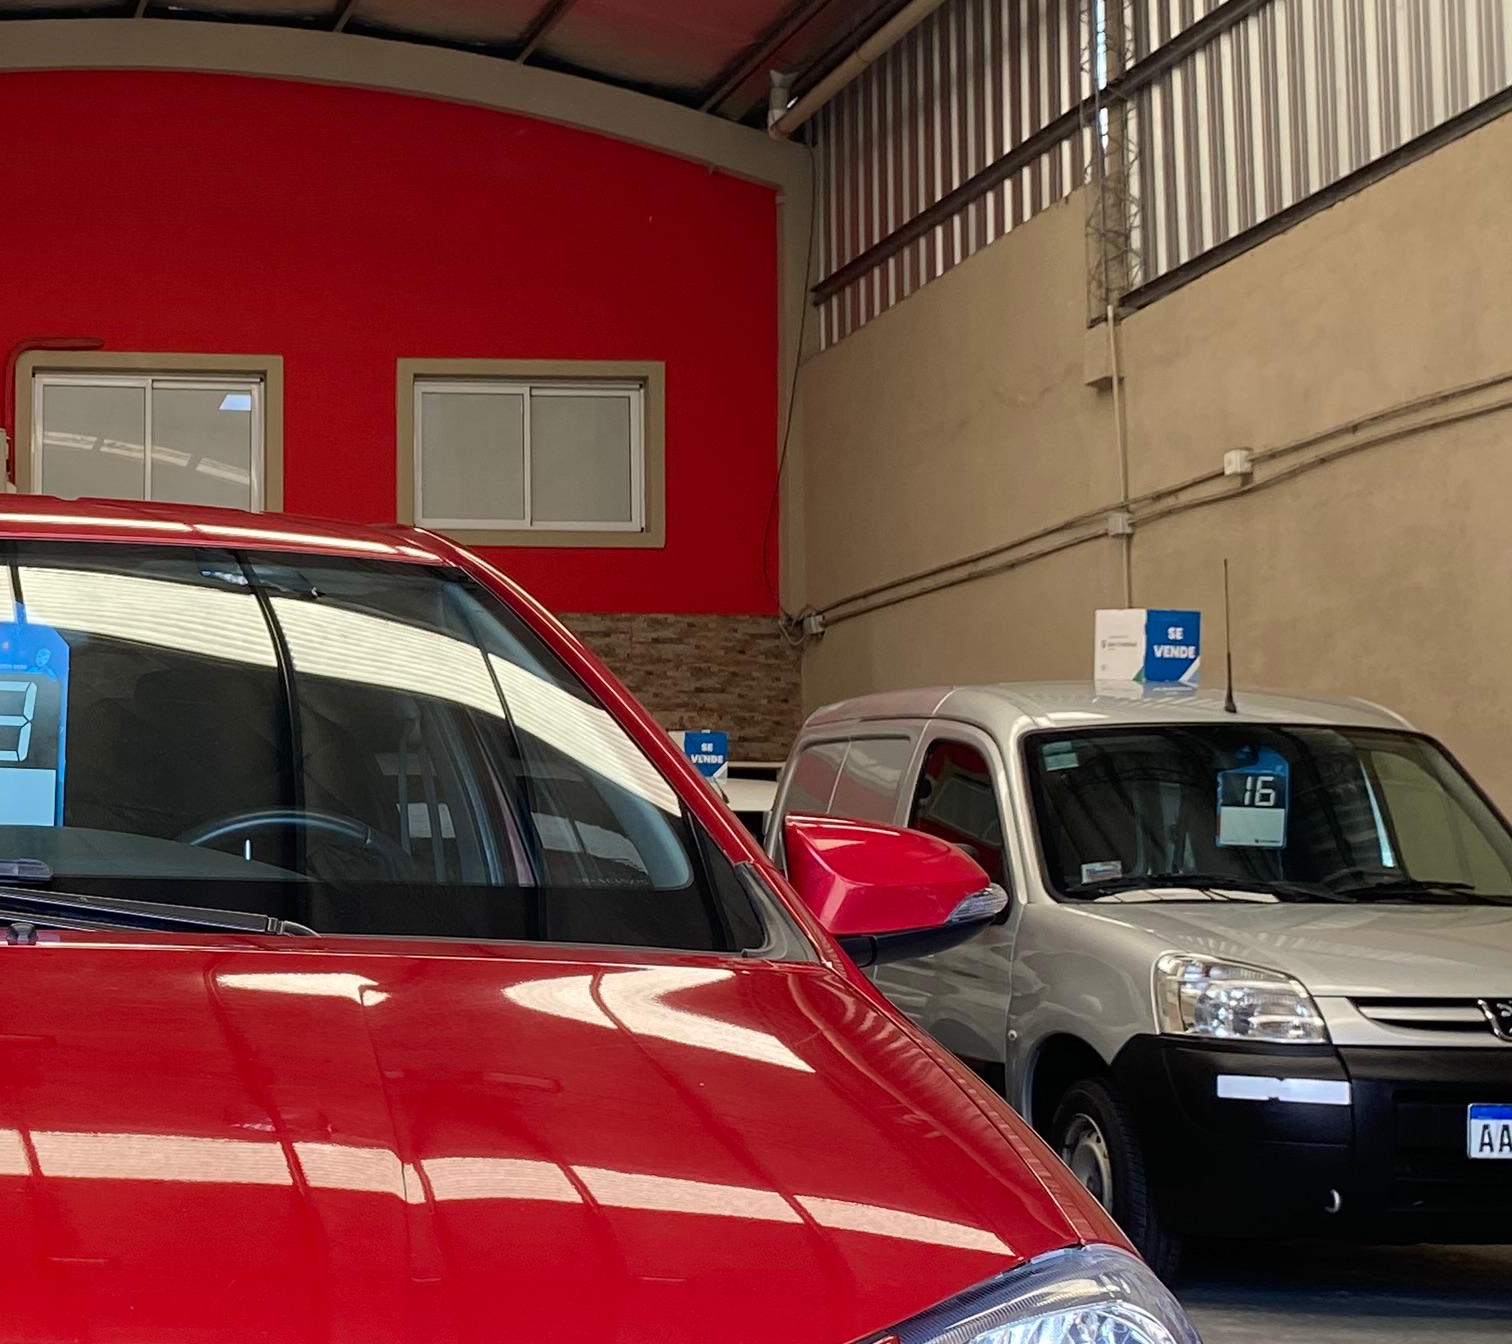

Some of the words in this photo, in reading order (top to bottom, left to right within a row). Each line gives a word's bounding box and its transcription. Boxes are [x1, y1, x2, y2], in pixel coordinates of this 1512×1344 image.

[1167, 626, 1184, 641] SE
[1153, 644, 1197, 659] VENDE
[690, 753, 724, 764] VENDE
[1243, 776, 1276, 806] 16
[1479, 1123, 1512, 1153] AA
